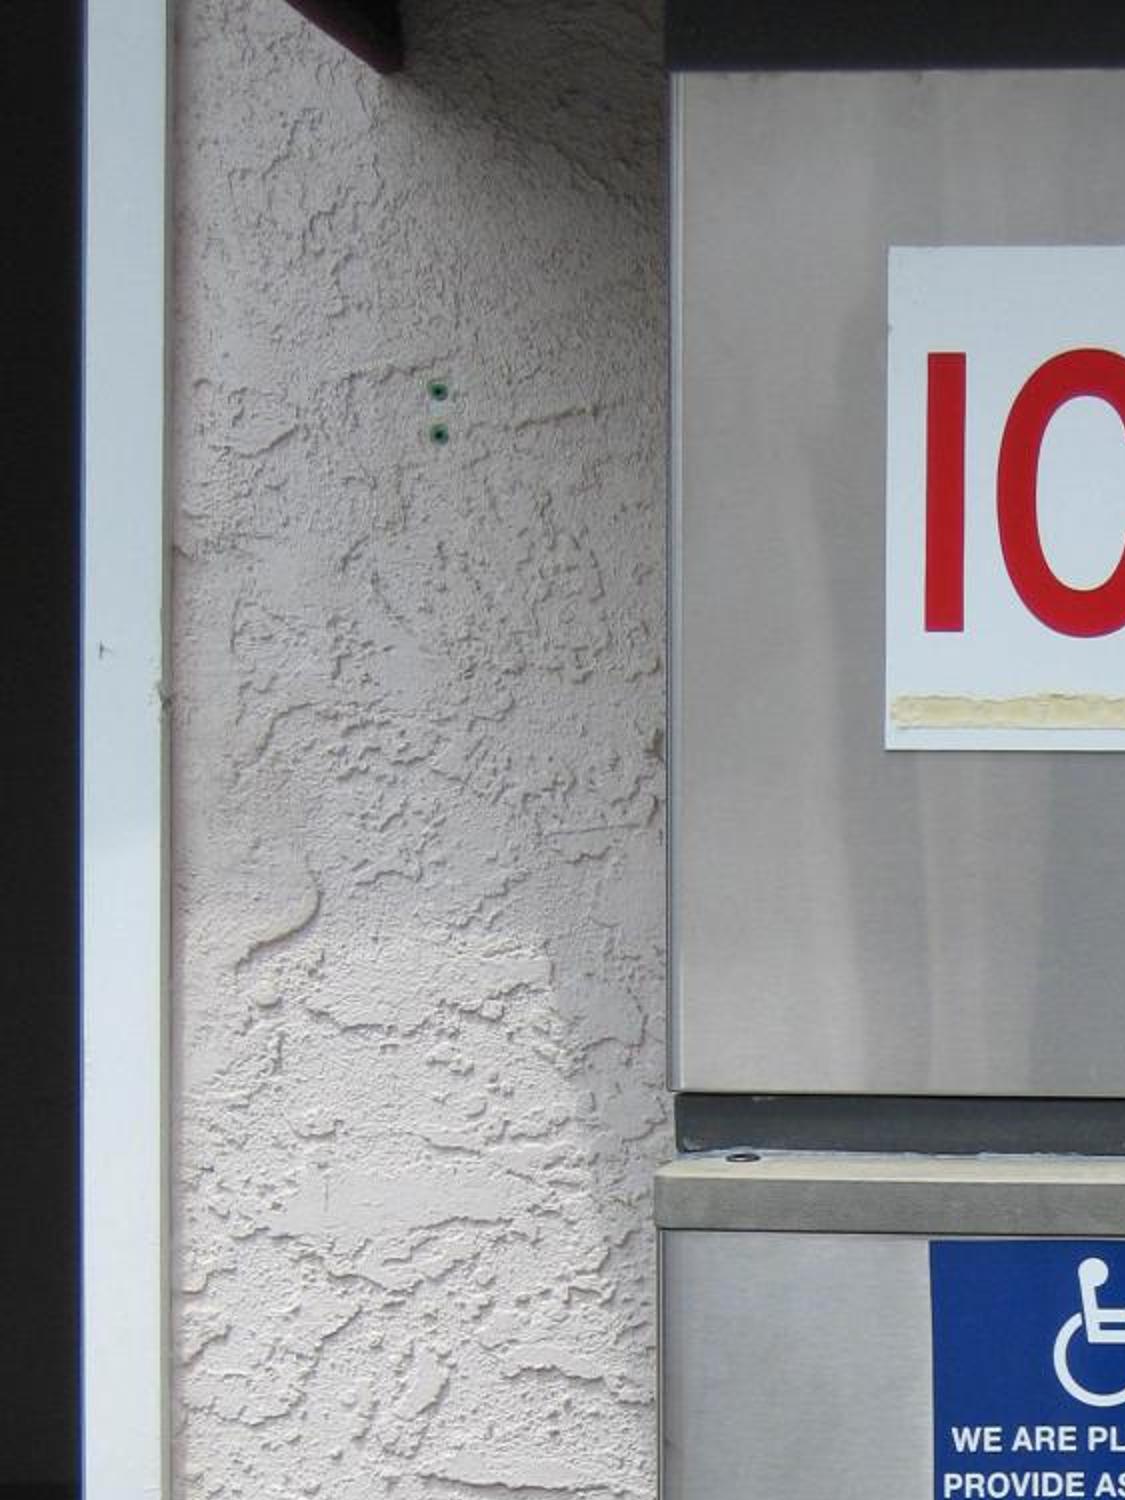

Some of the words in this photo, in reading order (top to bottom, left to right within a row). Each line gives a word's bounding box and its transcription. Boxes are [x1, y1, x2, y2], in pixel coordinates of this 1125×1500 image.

[952, 1426, 1003, 1453] WE
[1012, 1426, 1077, 1452] ARE
[943, 1472, 1085, 1499] PROVIDE
